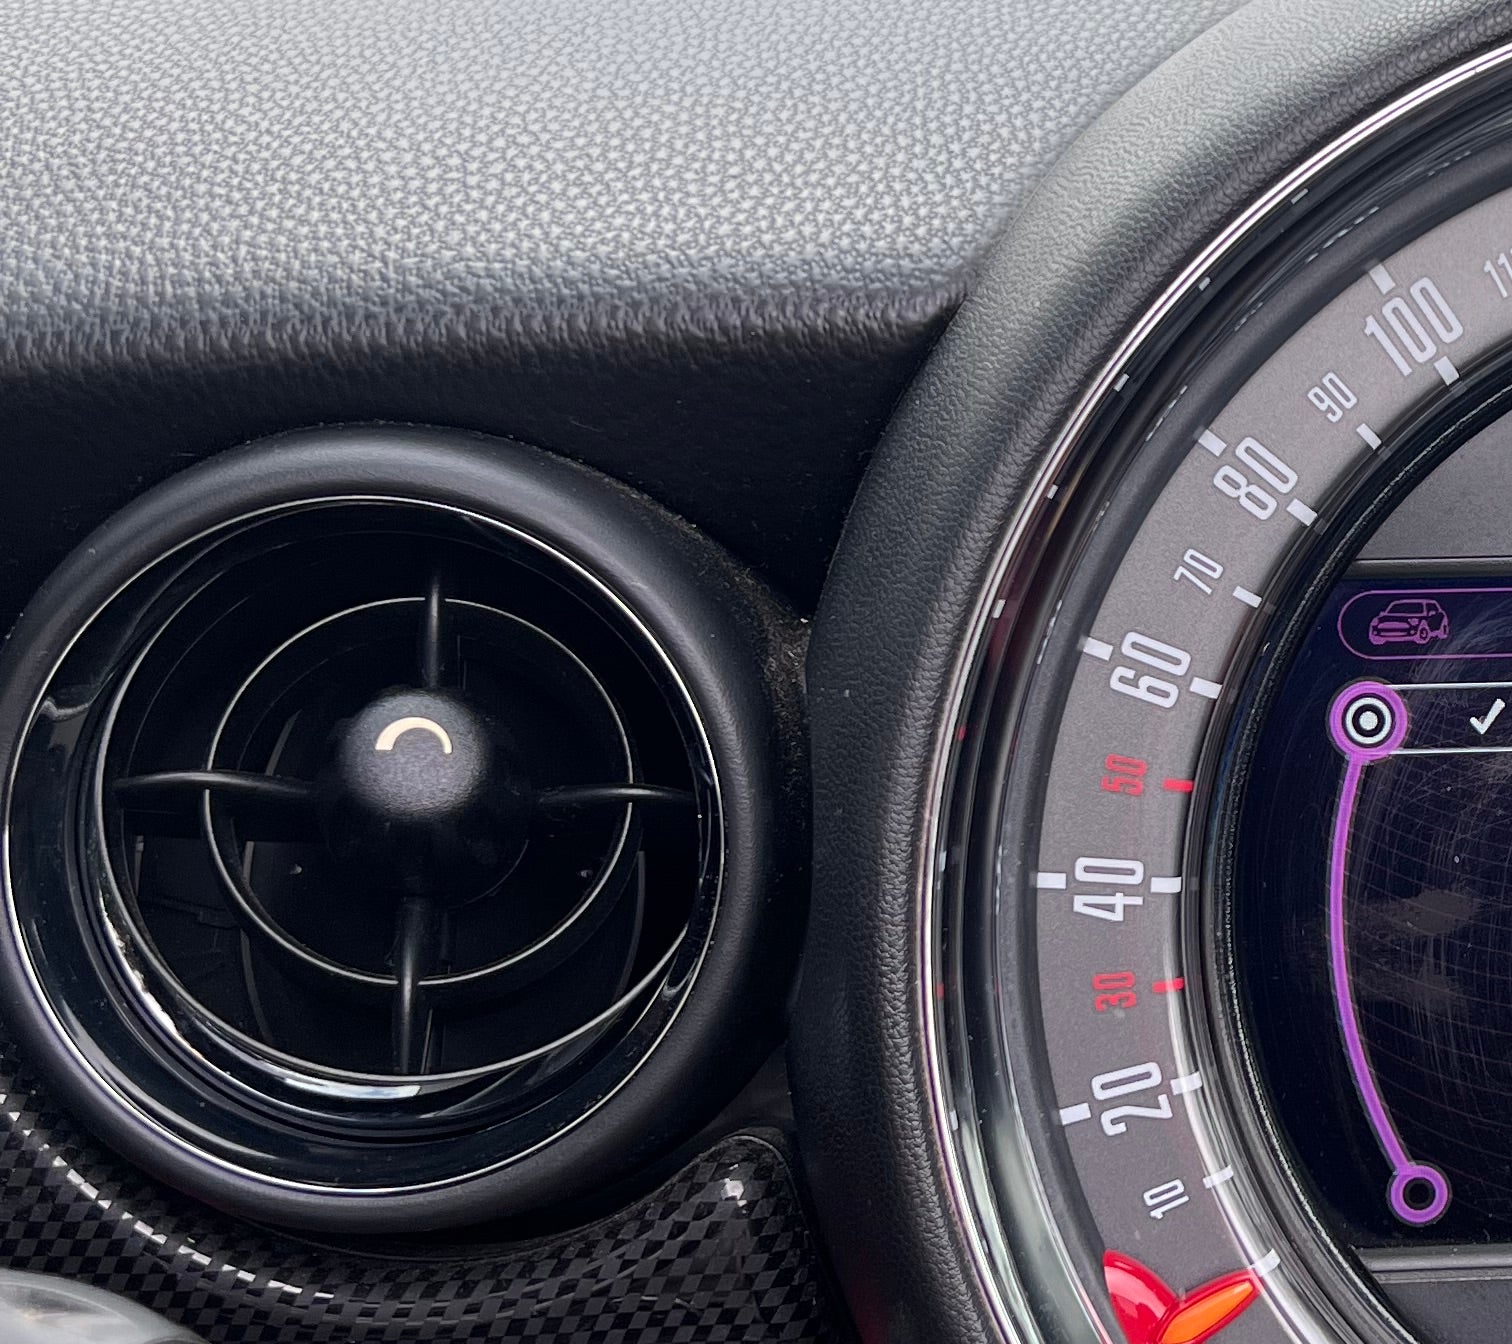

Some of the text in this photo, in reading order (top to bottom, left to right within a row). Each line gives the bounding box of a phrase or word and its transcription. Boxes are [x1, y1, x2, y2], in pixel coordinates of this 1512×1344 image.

[1364, 276, 1464, 377] 100
[1307, 372, 1358, 423] 90
[1213, 436, 1300, 522] 80
[1173, 548, 1224, 596] 70
[1110, 632, 1191, 709] 60
[1101, 754, 1147, 796] 50
[1073, 856, 1145, 923] 40
[1094, 971, 1138, 1010] 30
[1091, 1062, 1173, 1137] 20
[1143, 1179, 1191, 1221] 10
